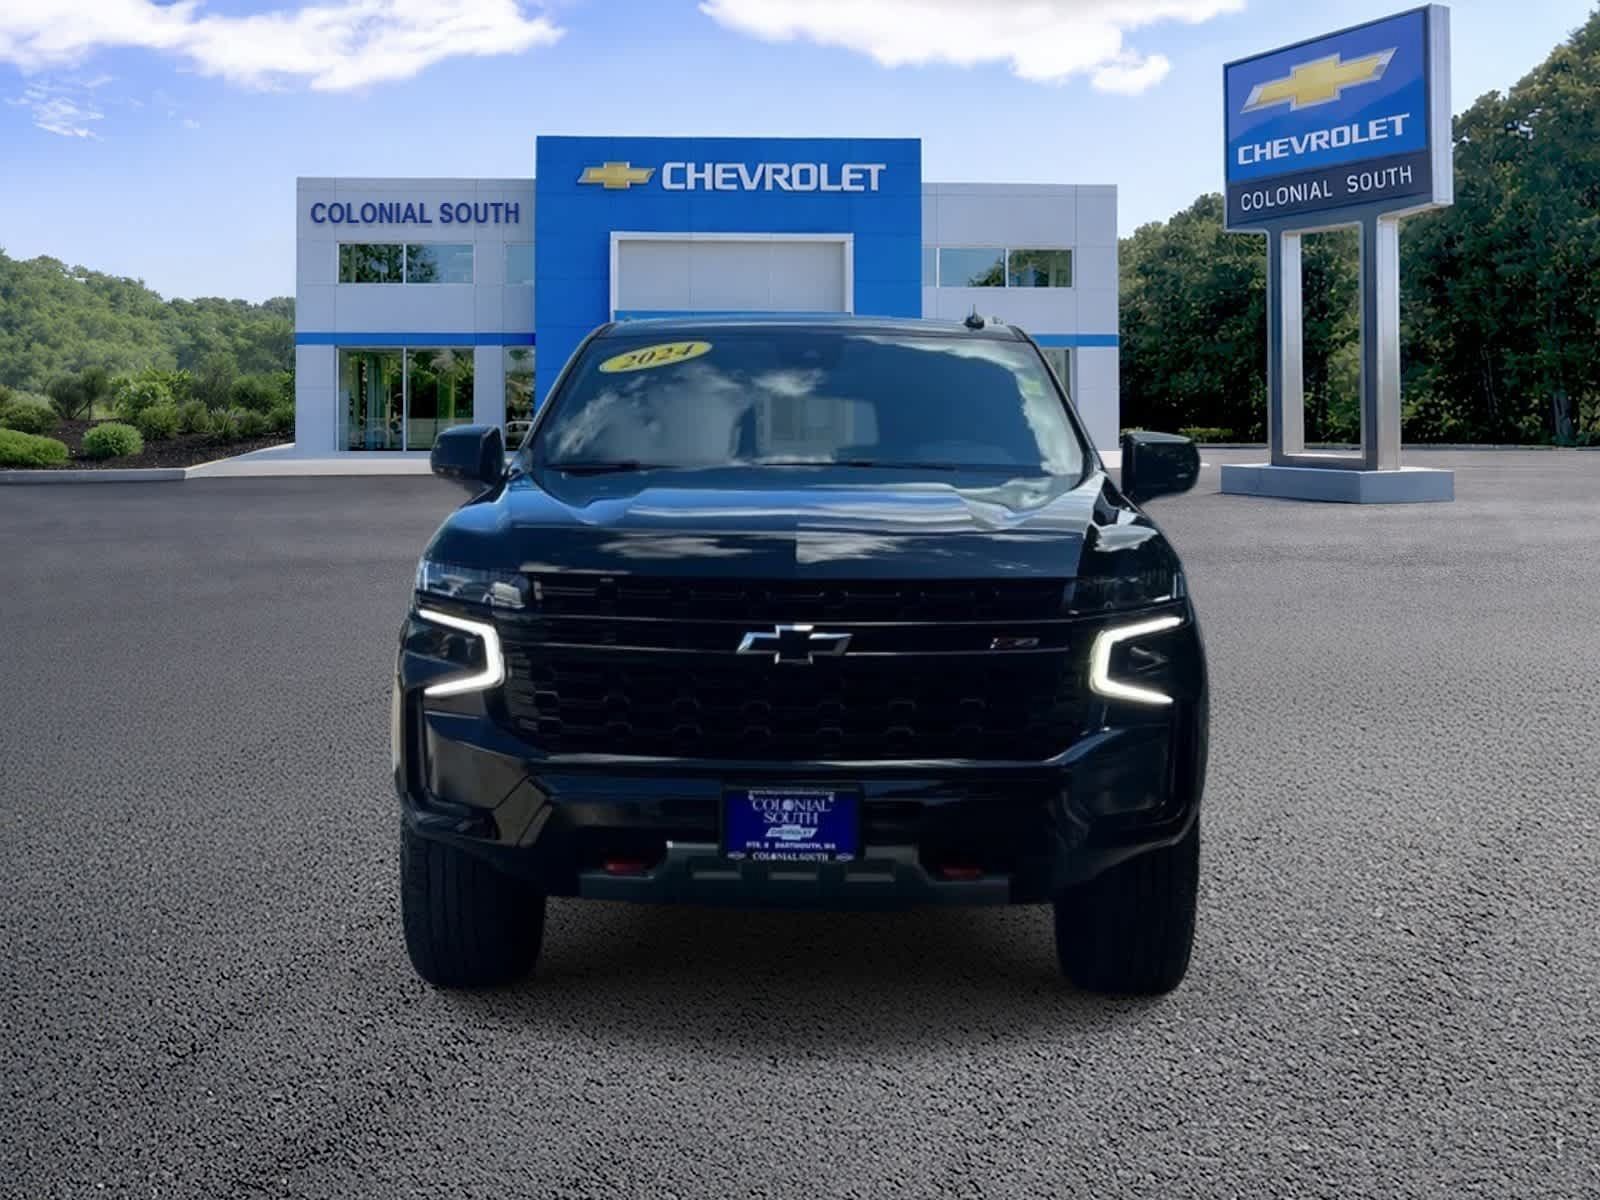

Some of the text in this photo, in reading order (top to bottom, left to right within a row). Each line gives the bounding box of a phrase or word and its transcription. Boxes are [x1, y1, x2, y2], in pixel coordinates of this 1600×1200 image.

[1238, 113, 1410, 165] CHEVROLET
[662, 162, 886, 191] CHEVROLET
[1241, 165, 1412, 211] COLONIAL SOUTH
[310, 202, 520, 224] COLONIAL SOUTH
[619, 344, 695, 368] 2024
[752, 799, 832, 812] COLONIAL
[763, 812, 818, 825] SOUTH
